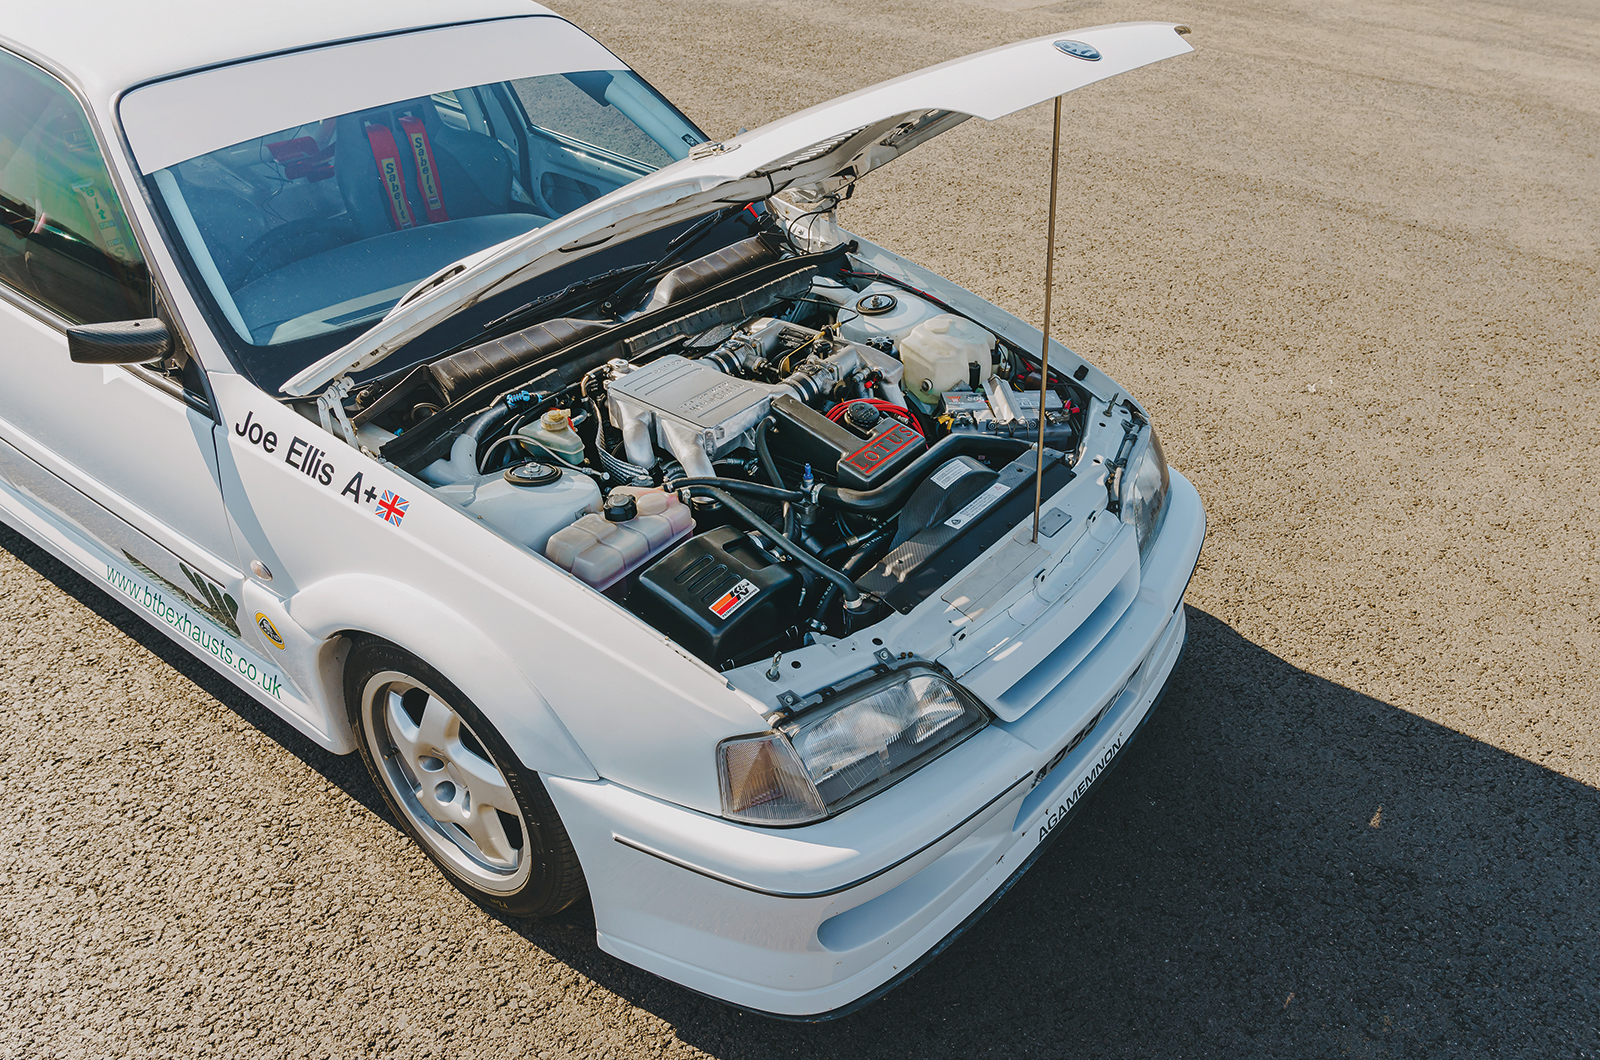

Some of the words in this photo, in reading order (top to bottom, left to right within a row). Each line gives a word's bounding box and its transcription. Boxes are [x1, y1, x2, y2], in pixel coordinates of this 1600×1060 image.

[385, 162, 406, 220] Sabelt
[414, 137, 435, 194] Sabelt
[235, 410, 278, 453] Joe
[284, 436, 335, 486] Ellis
[340, 471, 378, 504] A+
[850, 426, 914, 471] LOTUS
[106, 564, 282, 700] www.btbexhausts.co.uk
[1039, 737, 1122, 842] AGAMEMNON
